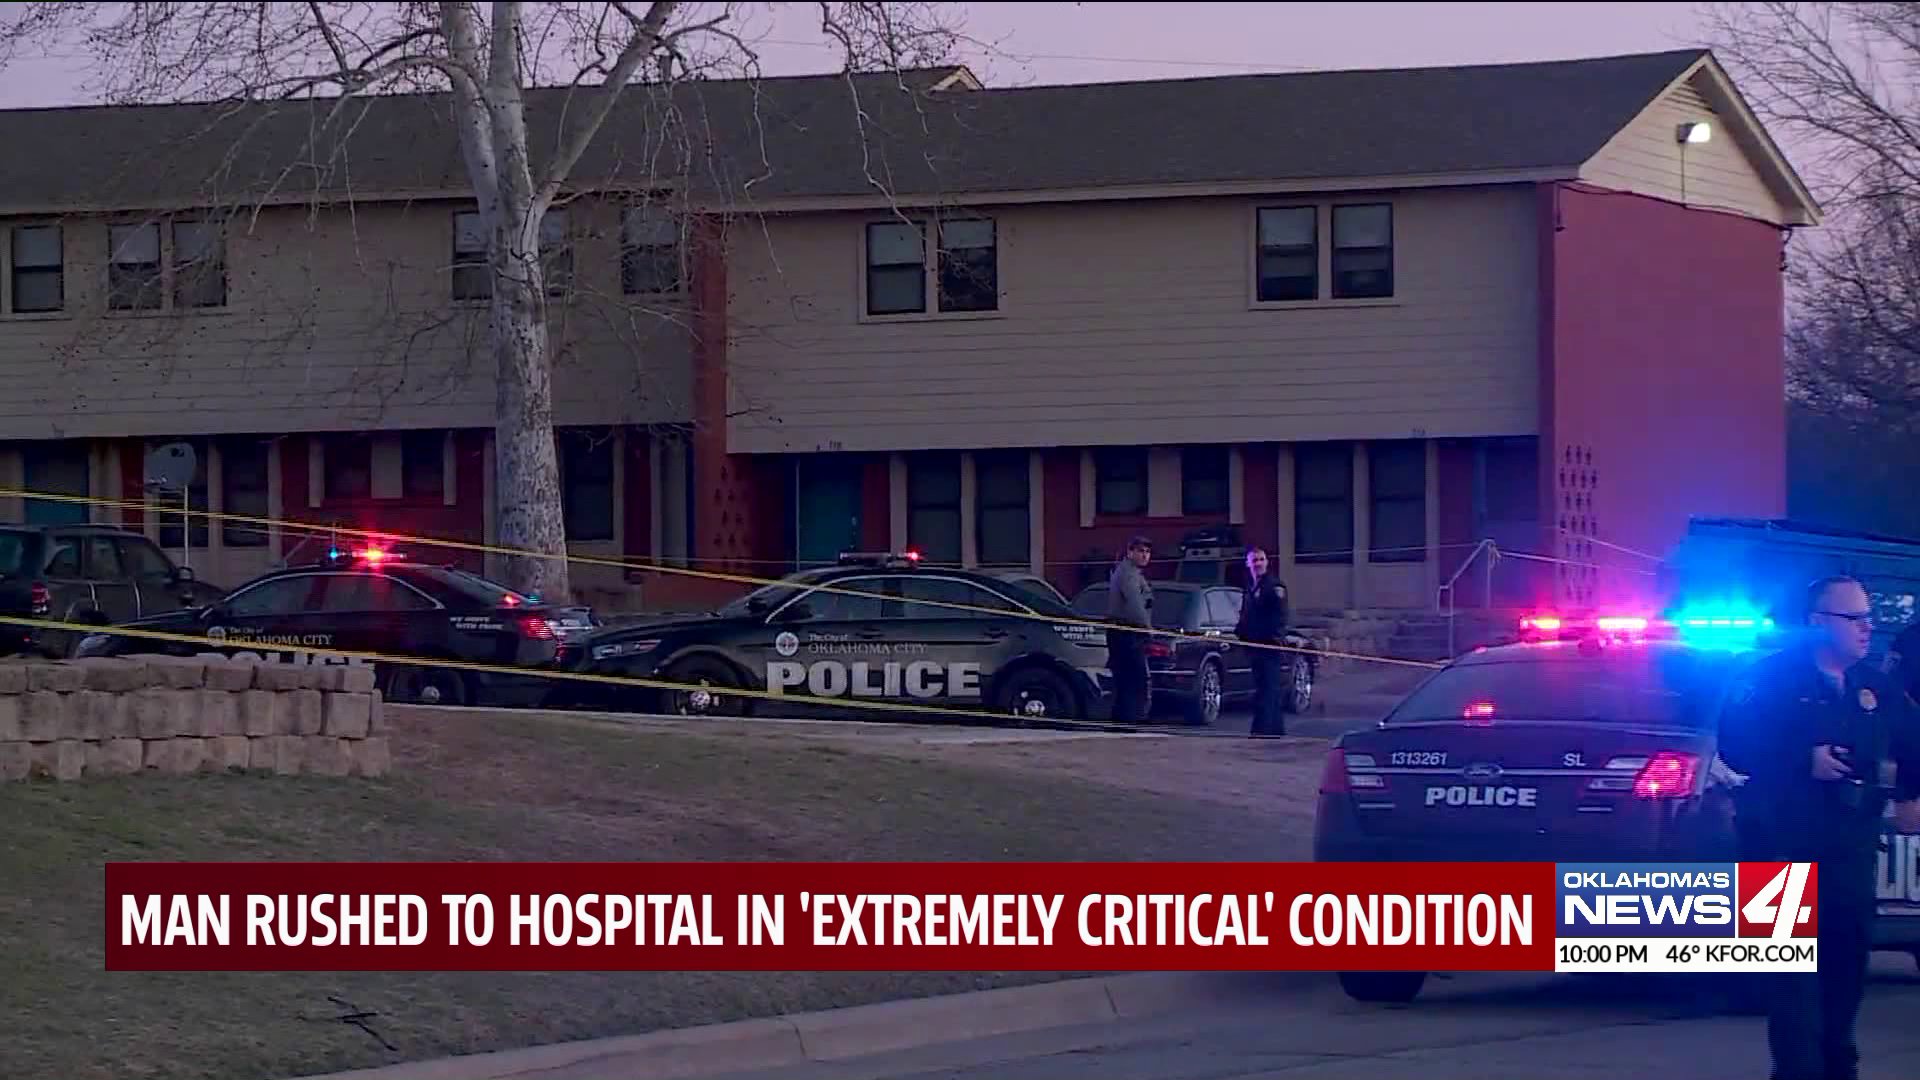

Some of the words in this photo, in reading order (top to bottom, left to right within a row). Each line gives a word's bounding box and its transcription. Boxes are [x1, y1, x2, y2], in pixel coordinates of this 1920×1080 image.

[303, 634, 333, 645] CITY
[808, 642, 890, 654] OKLAHOMA
[894, 642, 928, 654] CITY
[766, 660, 981, 698] POLICE
[1391, 752, 1448, 766] 1313261
[1564, 753, 1587, 767] SL
[1425, 786, 1537, 806] POLICE
